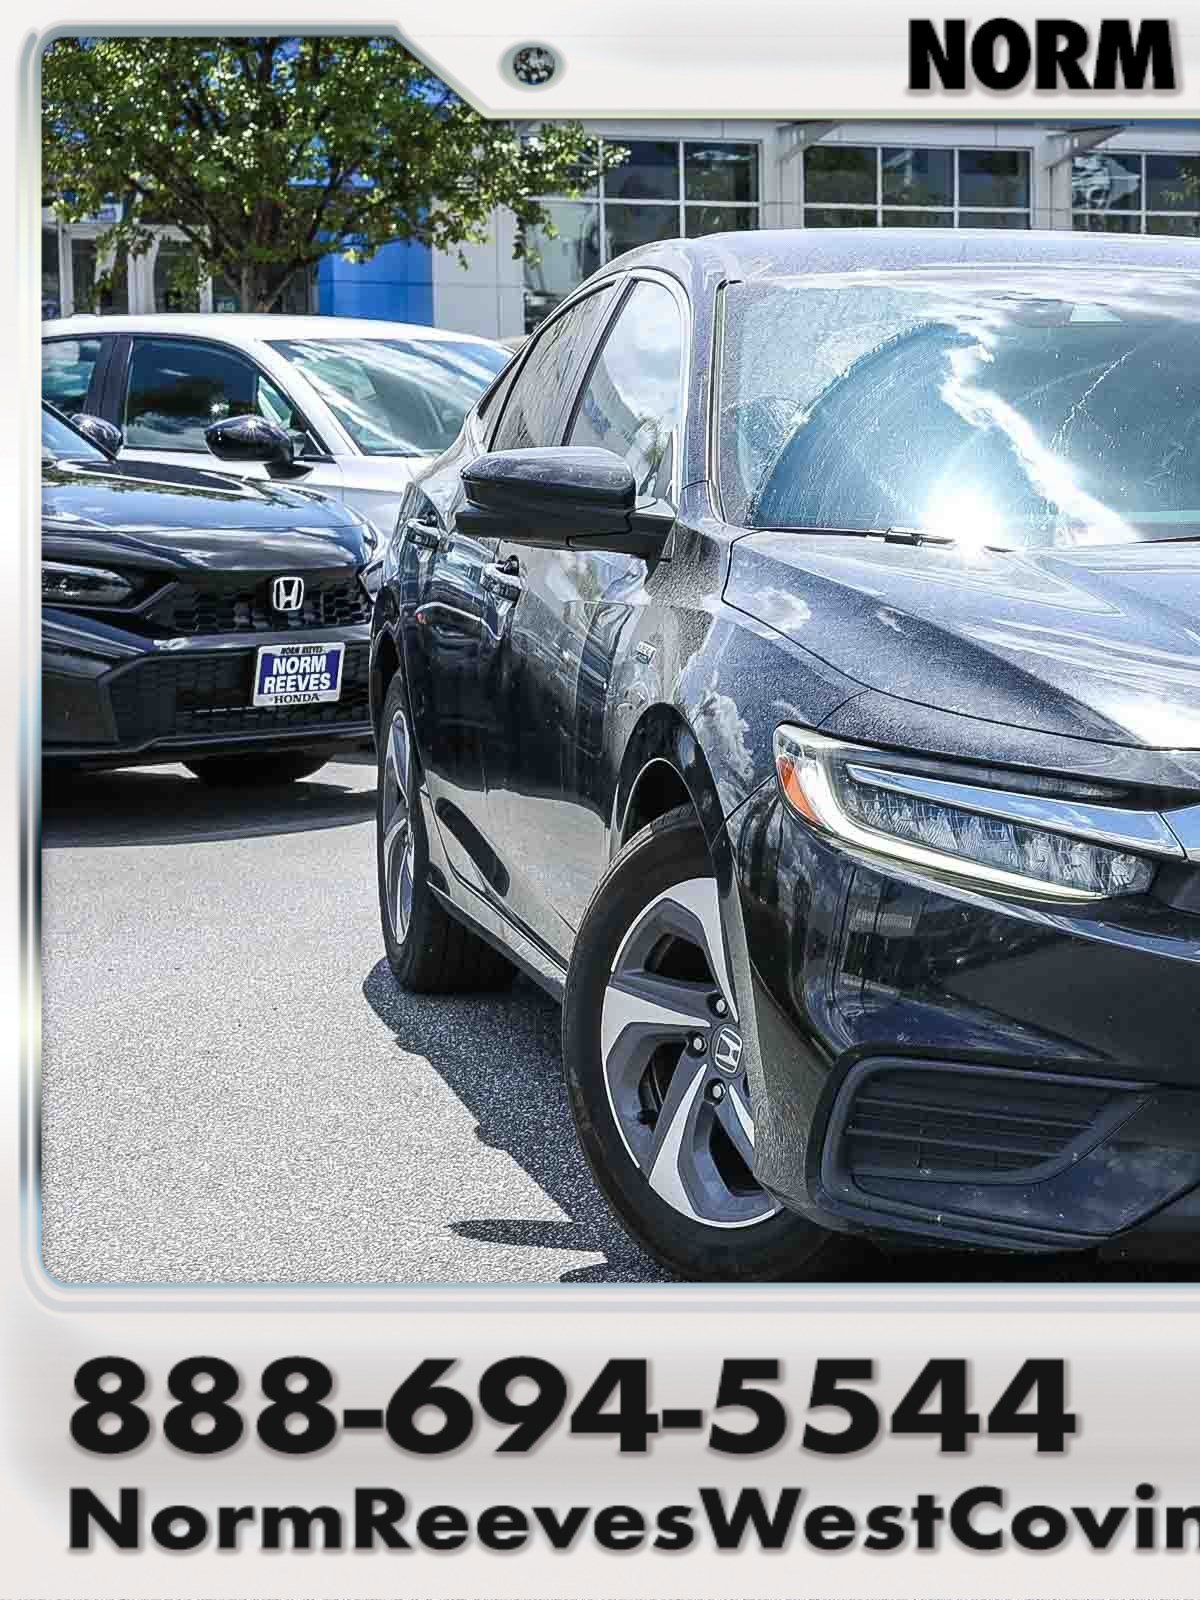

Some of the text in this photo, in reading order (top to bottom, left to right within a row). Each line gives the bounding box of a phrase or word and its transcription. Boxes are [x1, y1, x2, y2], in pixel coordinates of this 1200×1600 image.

[272, 655, 327, 675] NORM
[263, 672, 331, 693] REEVES
[274, 693, 320, 704] HONDA
